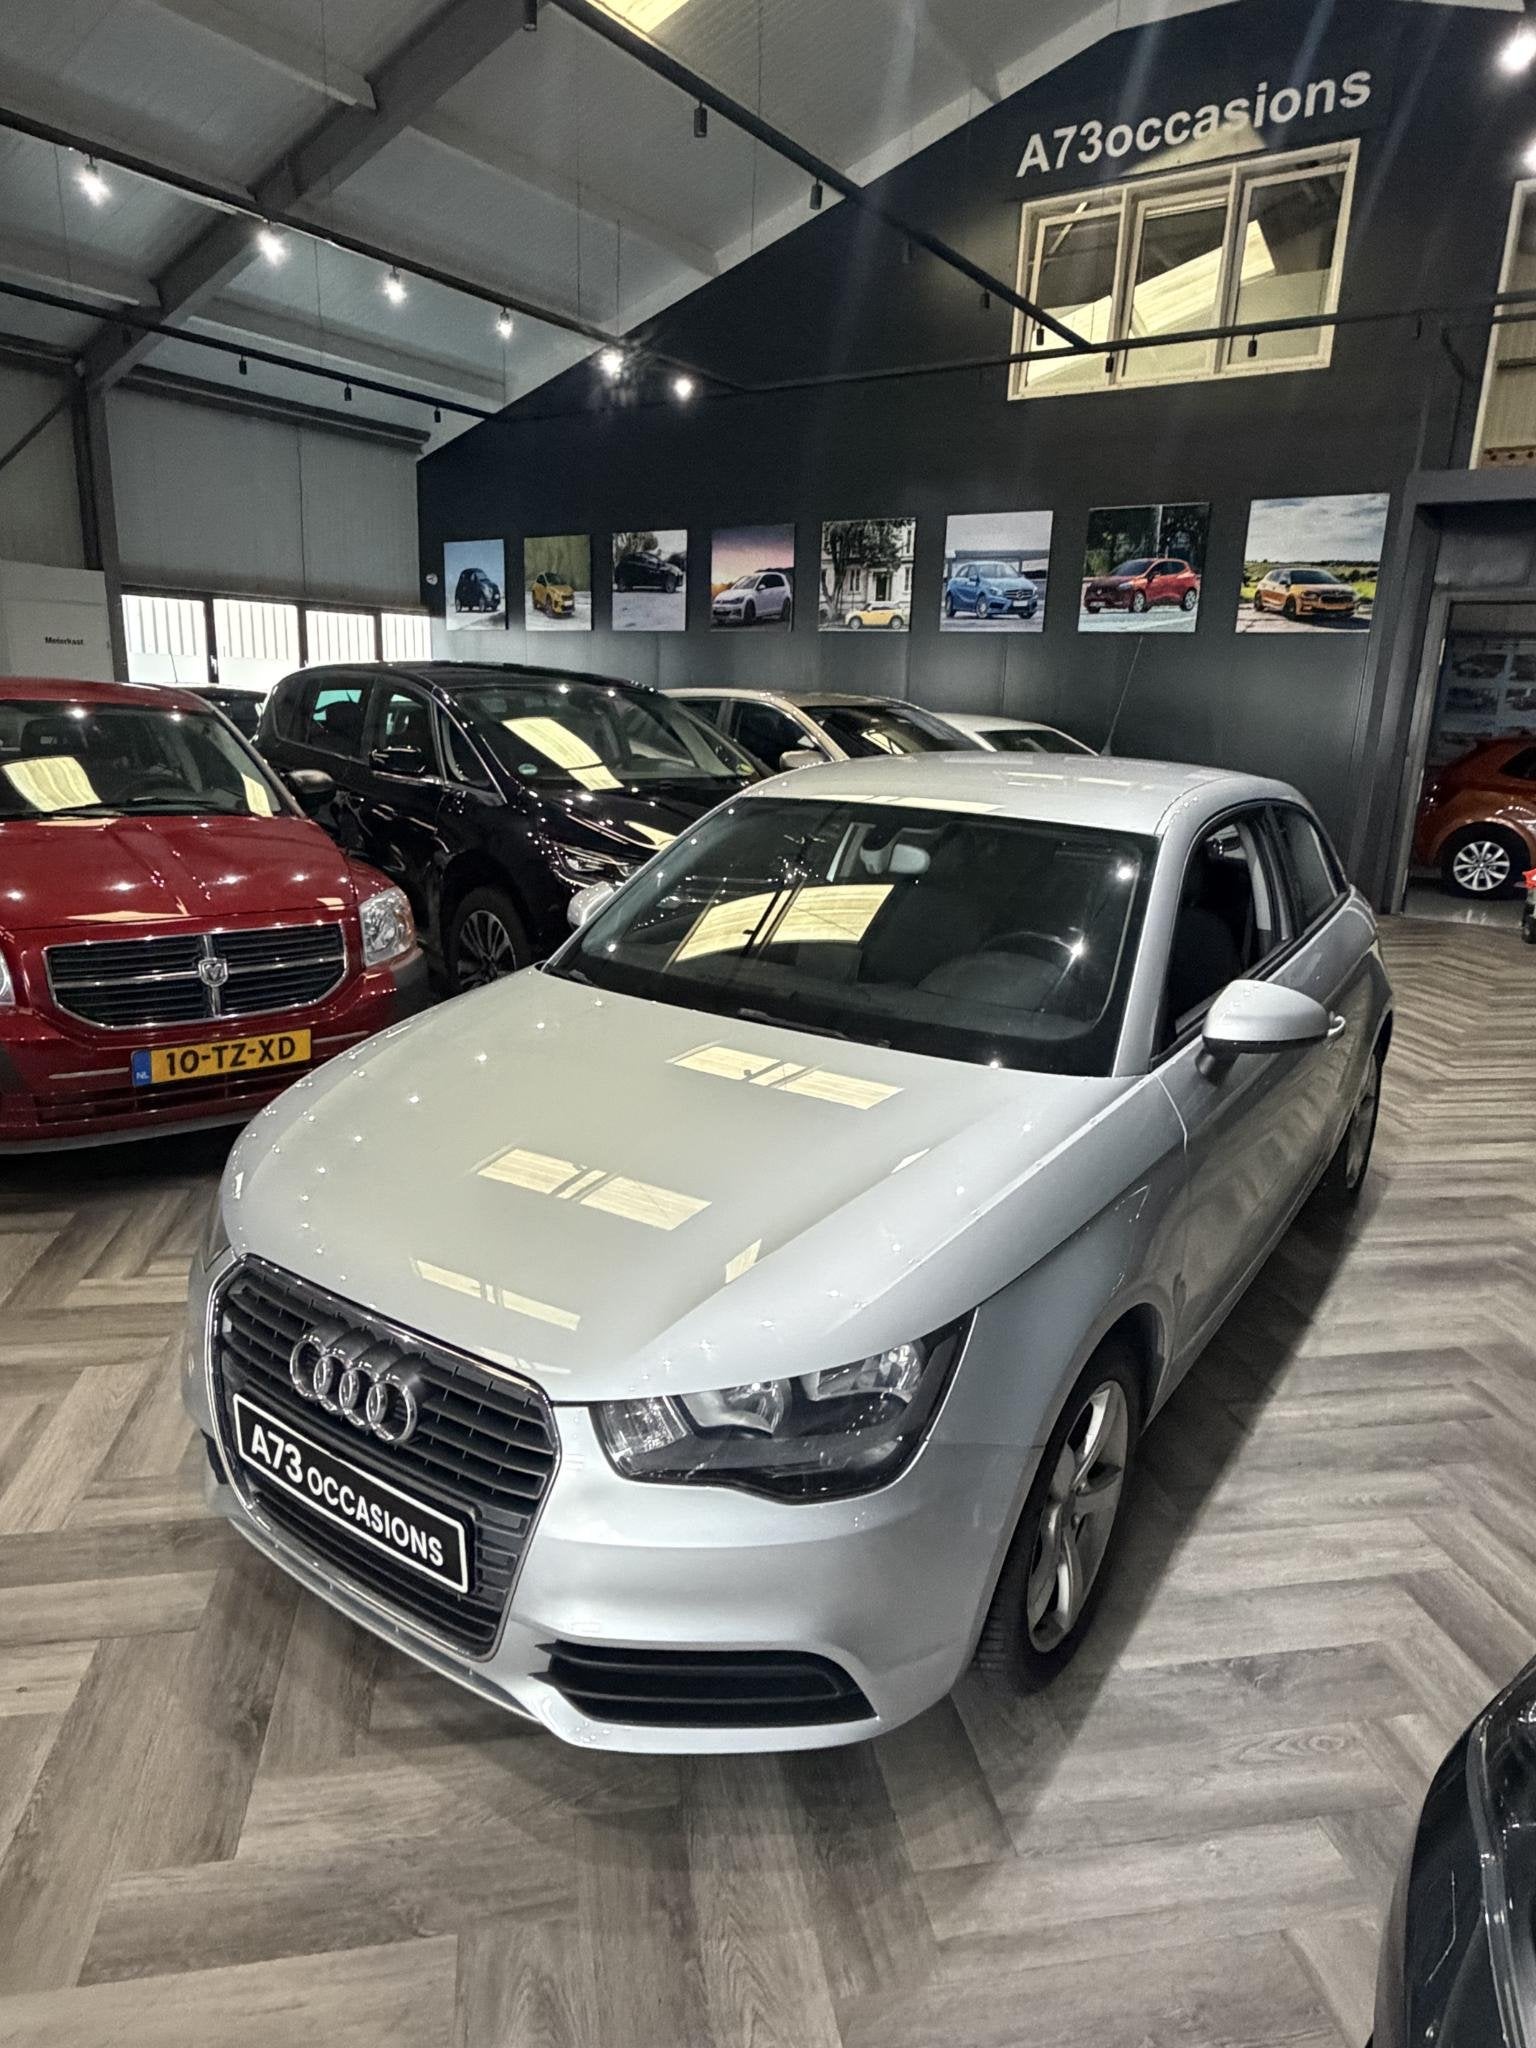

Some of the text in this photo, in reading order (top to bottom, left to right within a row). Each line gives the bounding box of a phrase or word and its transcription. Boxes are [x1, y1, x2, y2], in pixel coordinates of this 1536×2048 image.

[1016, 70, 1372, 178] A73occasions
[136, 1071, 150, 1080] NL
[166, 1036, 296, 1076] 10-TZ-XD
[251, 1423, 444, 1567] A73 OCCASIONS
